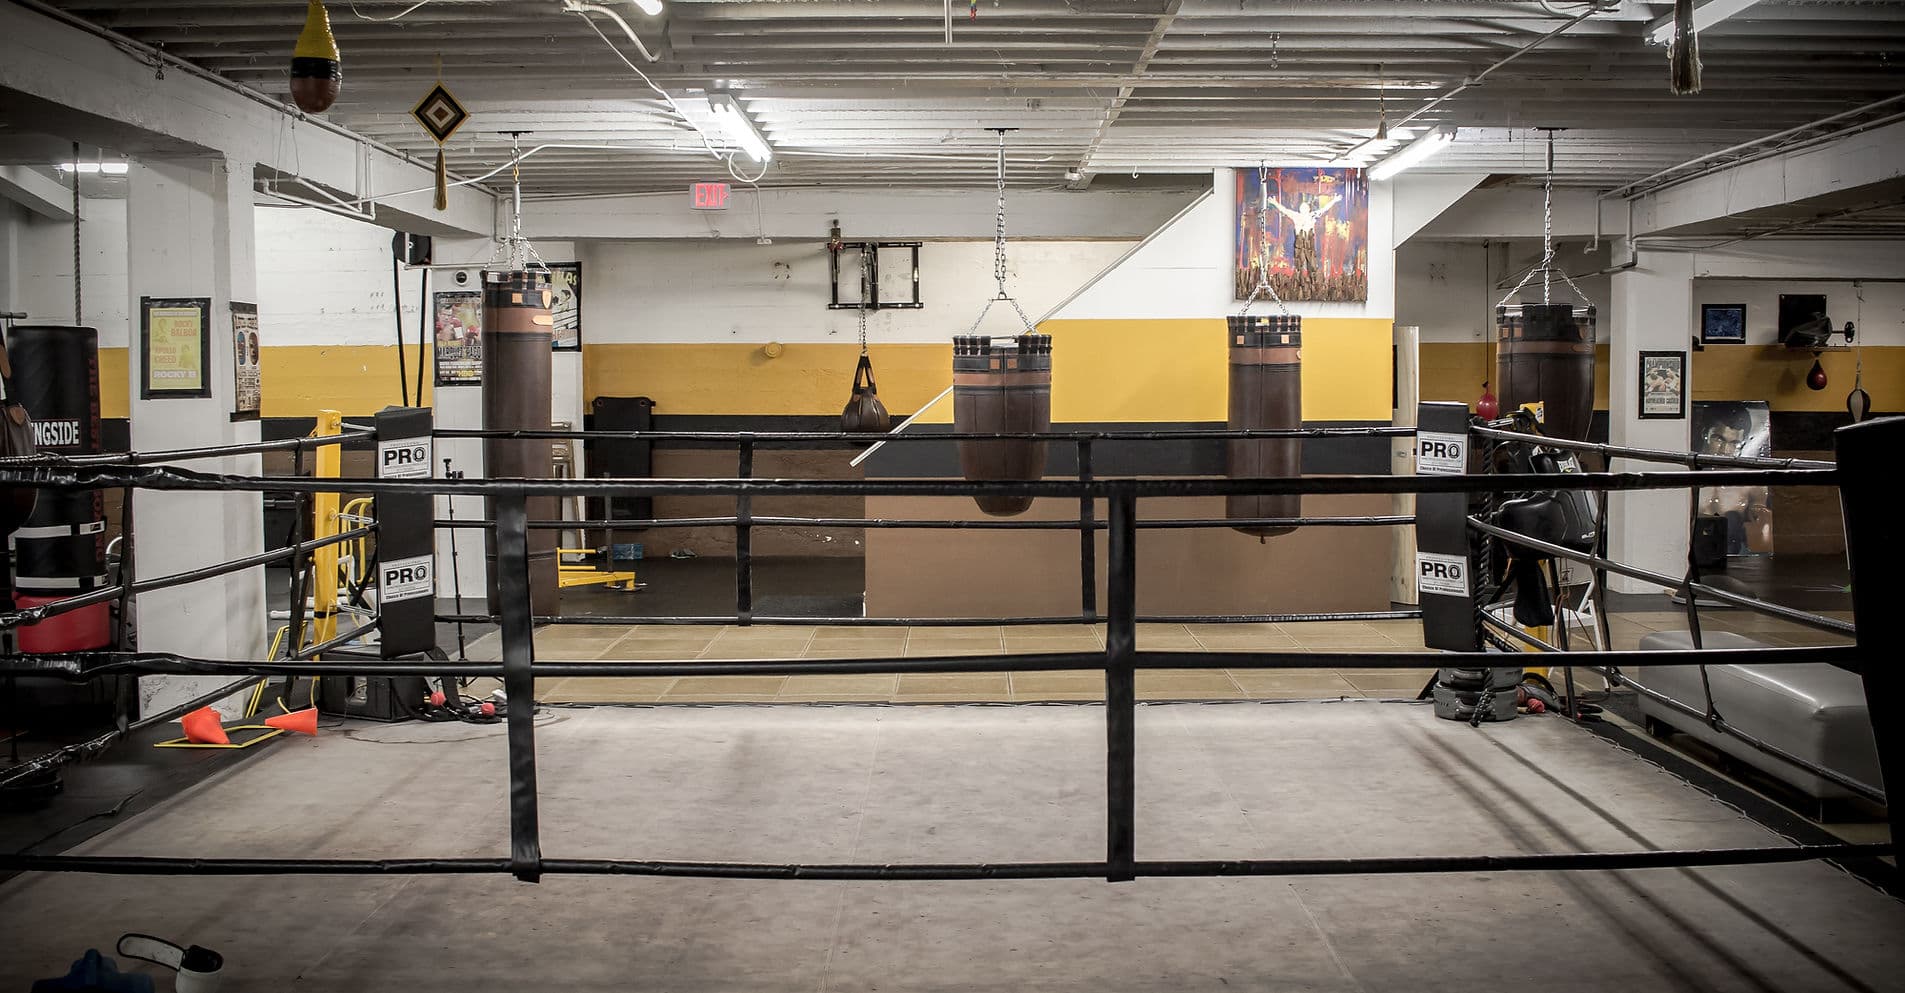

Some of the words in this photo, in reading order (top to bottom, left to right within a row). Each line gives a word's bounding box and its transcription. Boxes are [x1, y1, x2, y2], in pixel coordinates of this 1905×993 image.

[695, 183, 725, 207] EXIT
[31, 421, 80, 446] NGSIDE
[384, 446, 425, 465] PRO
[1421, 441, 1460, 459] PRO
[386, 565, 427, 585] PRO
[1421, 562, 1461, 579] PRO
